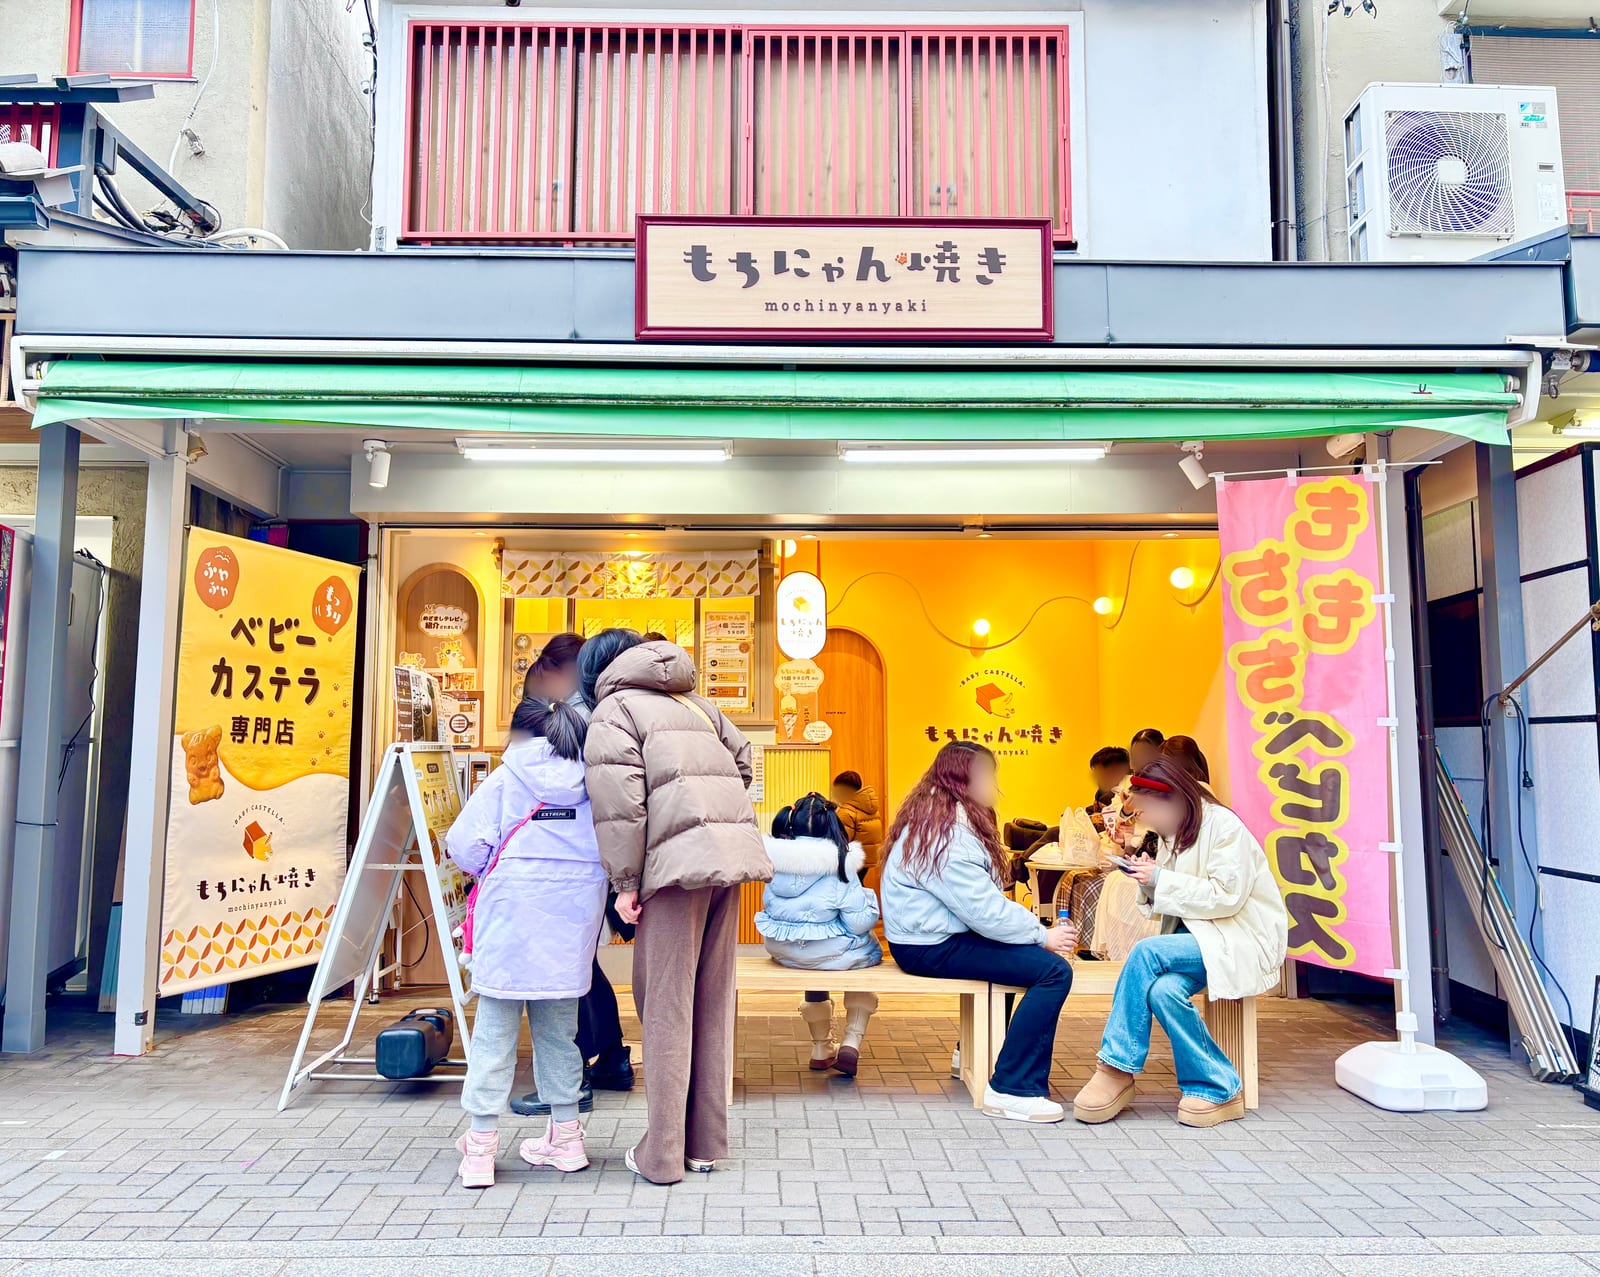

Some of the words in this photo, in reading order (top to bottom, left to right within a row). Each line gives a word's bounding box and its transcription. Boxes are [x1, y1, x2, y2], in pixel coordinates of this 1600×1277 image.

[683, 241, 1007, 289] もちにゃん焼き
[764, 299, 928, 314] mochinyanyaki
[203, 562, 229, 582] ふわ
[208, 581, 229, 597] ふわ
[231, 617, 316, 652] ベビー
[210, 657, 320, 704] カステラ
[984, 669, 1023, 686] CASTELLA
[230, 715, 295, 745] 専門店
[925, 724, 1063, 744] もちにゃん焼き
[196, 867, 317, 902] もちにゃん焼き
[227, 898, 287, 913] mochinyanyaki
